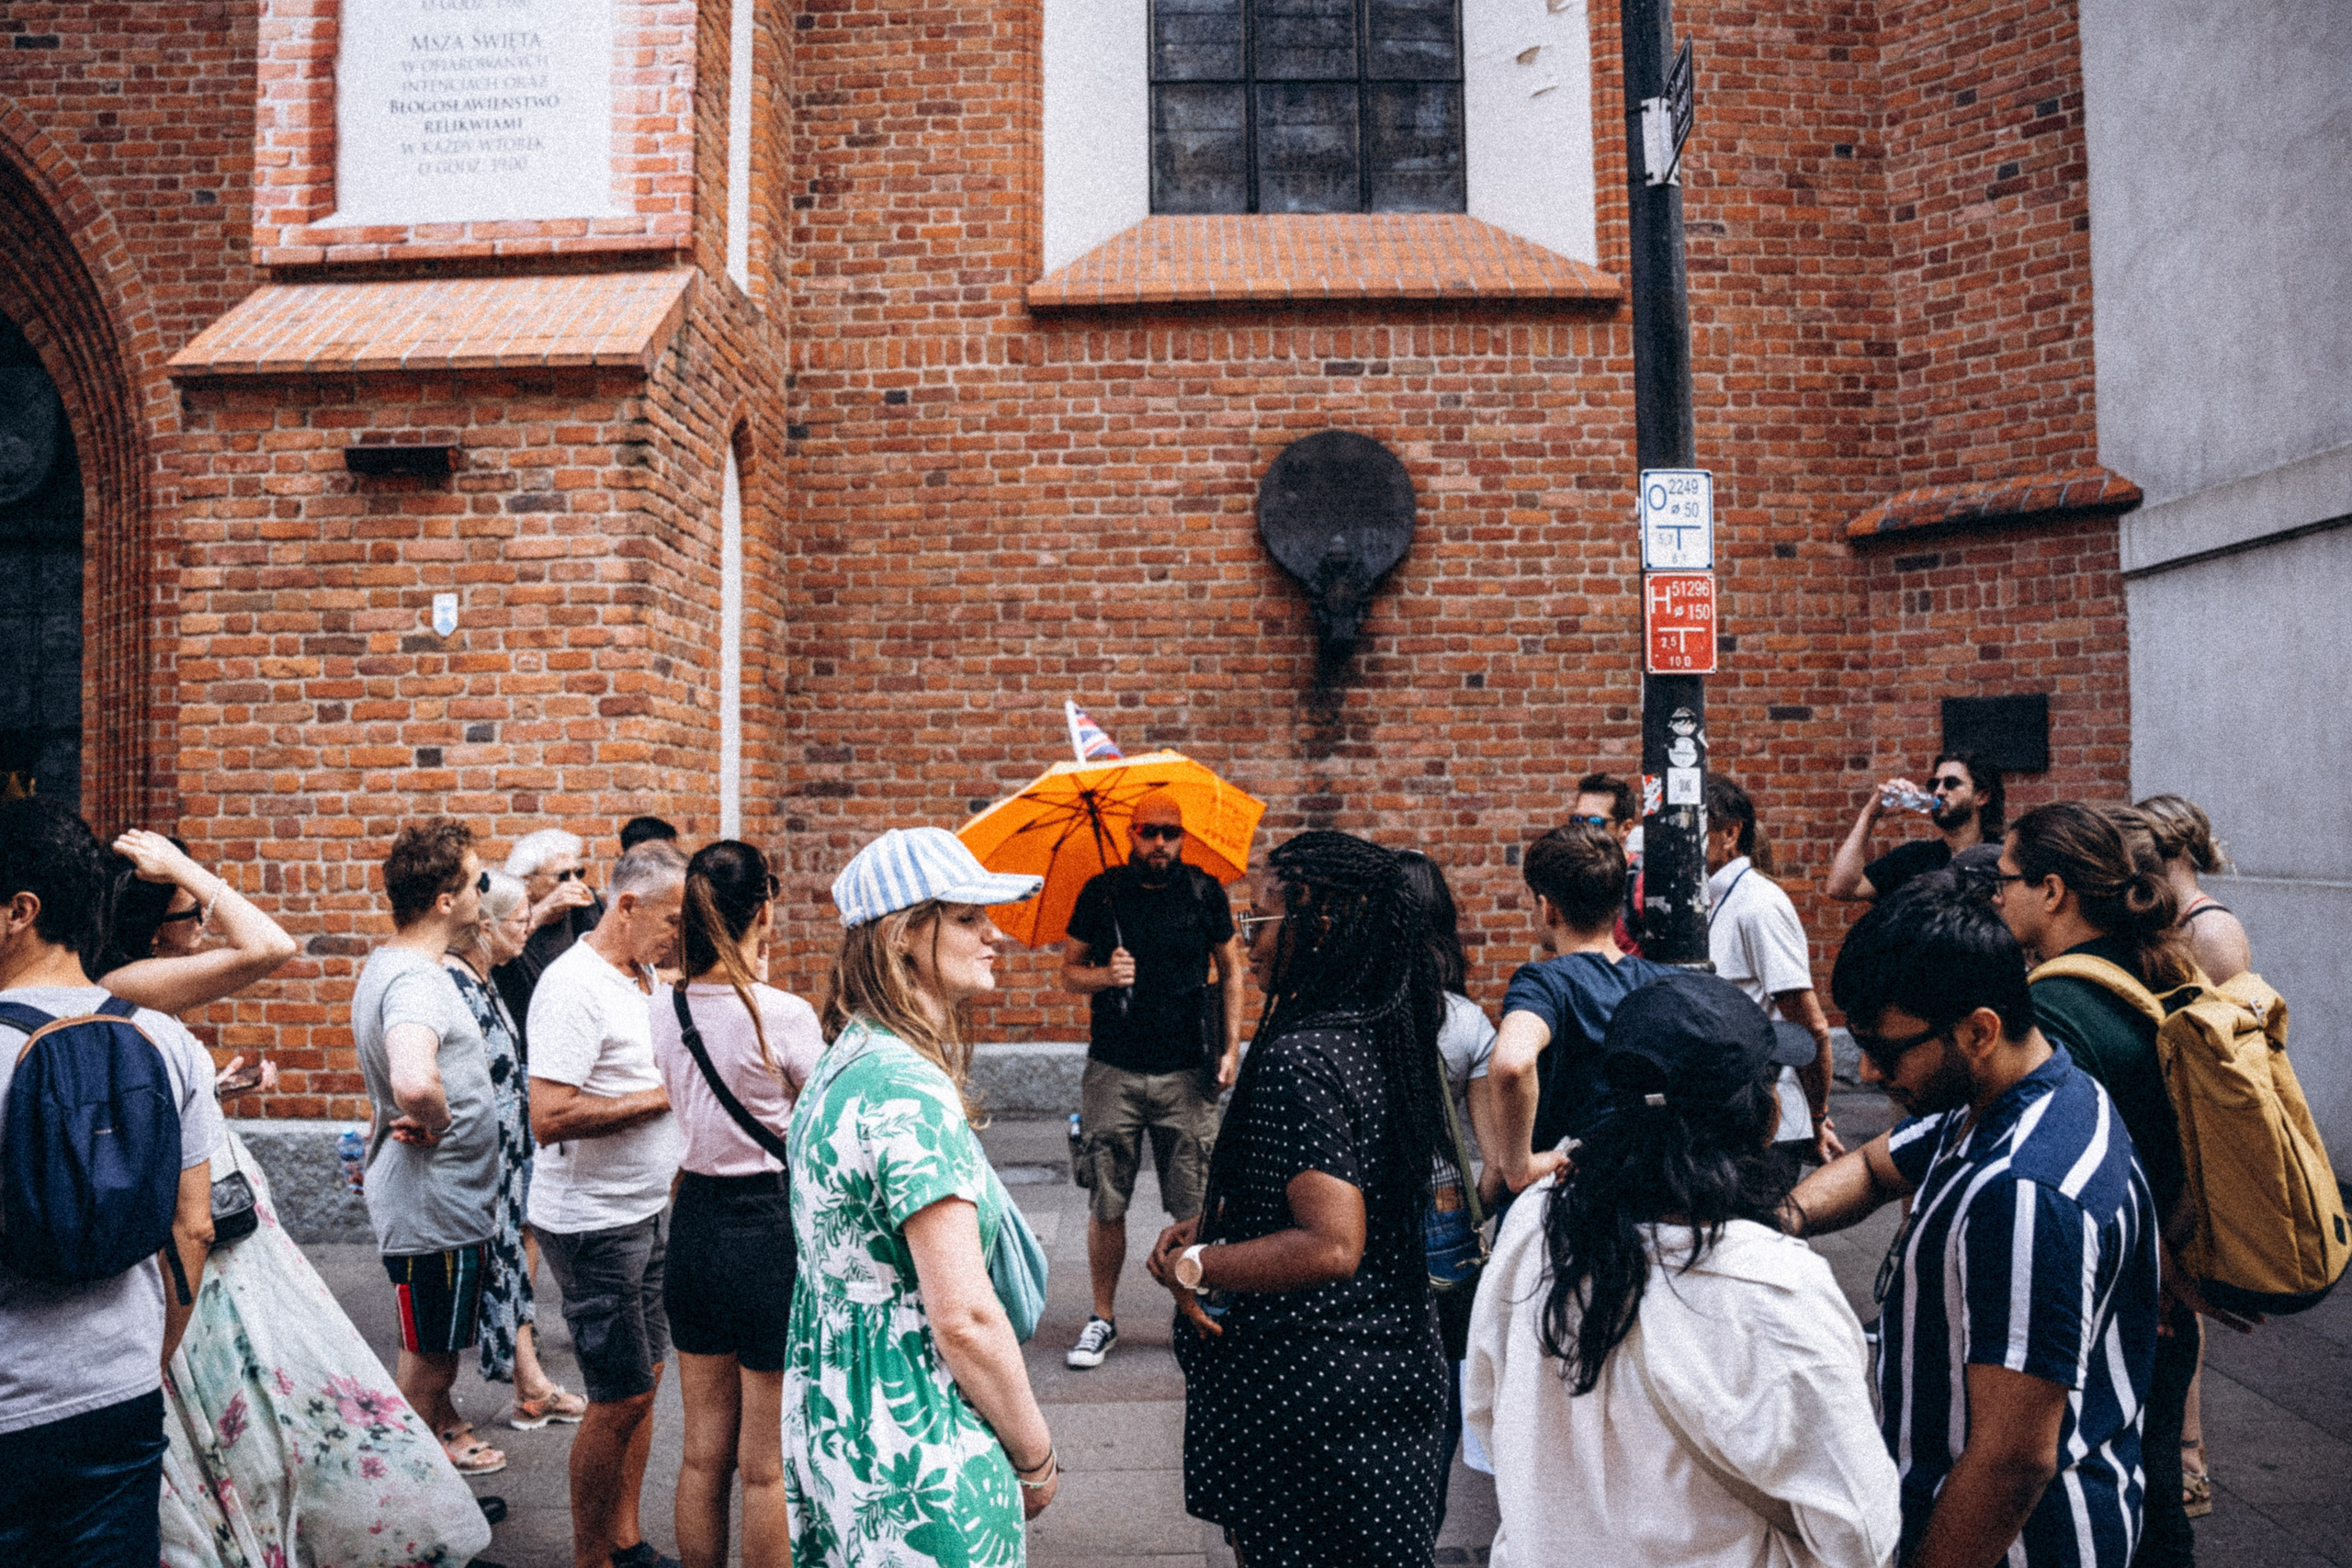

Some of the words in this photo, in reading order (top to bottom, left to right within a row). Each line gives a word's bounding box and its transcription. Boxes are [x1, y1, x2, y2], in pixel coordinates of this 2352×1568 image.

[411, 34, 464, 51] MSZA
[1668, 479, 1699, 495] 2249
[1684, 502, 1699, 517] 50
[1650, 585, 1671, 615] H
[1671, 580, 1710, 597] 51296
[1688, 603, 1710, 620] 150
